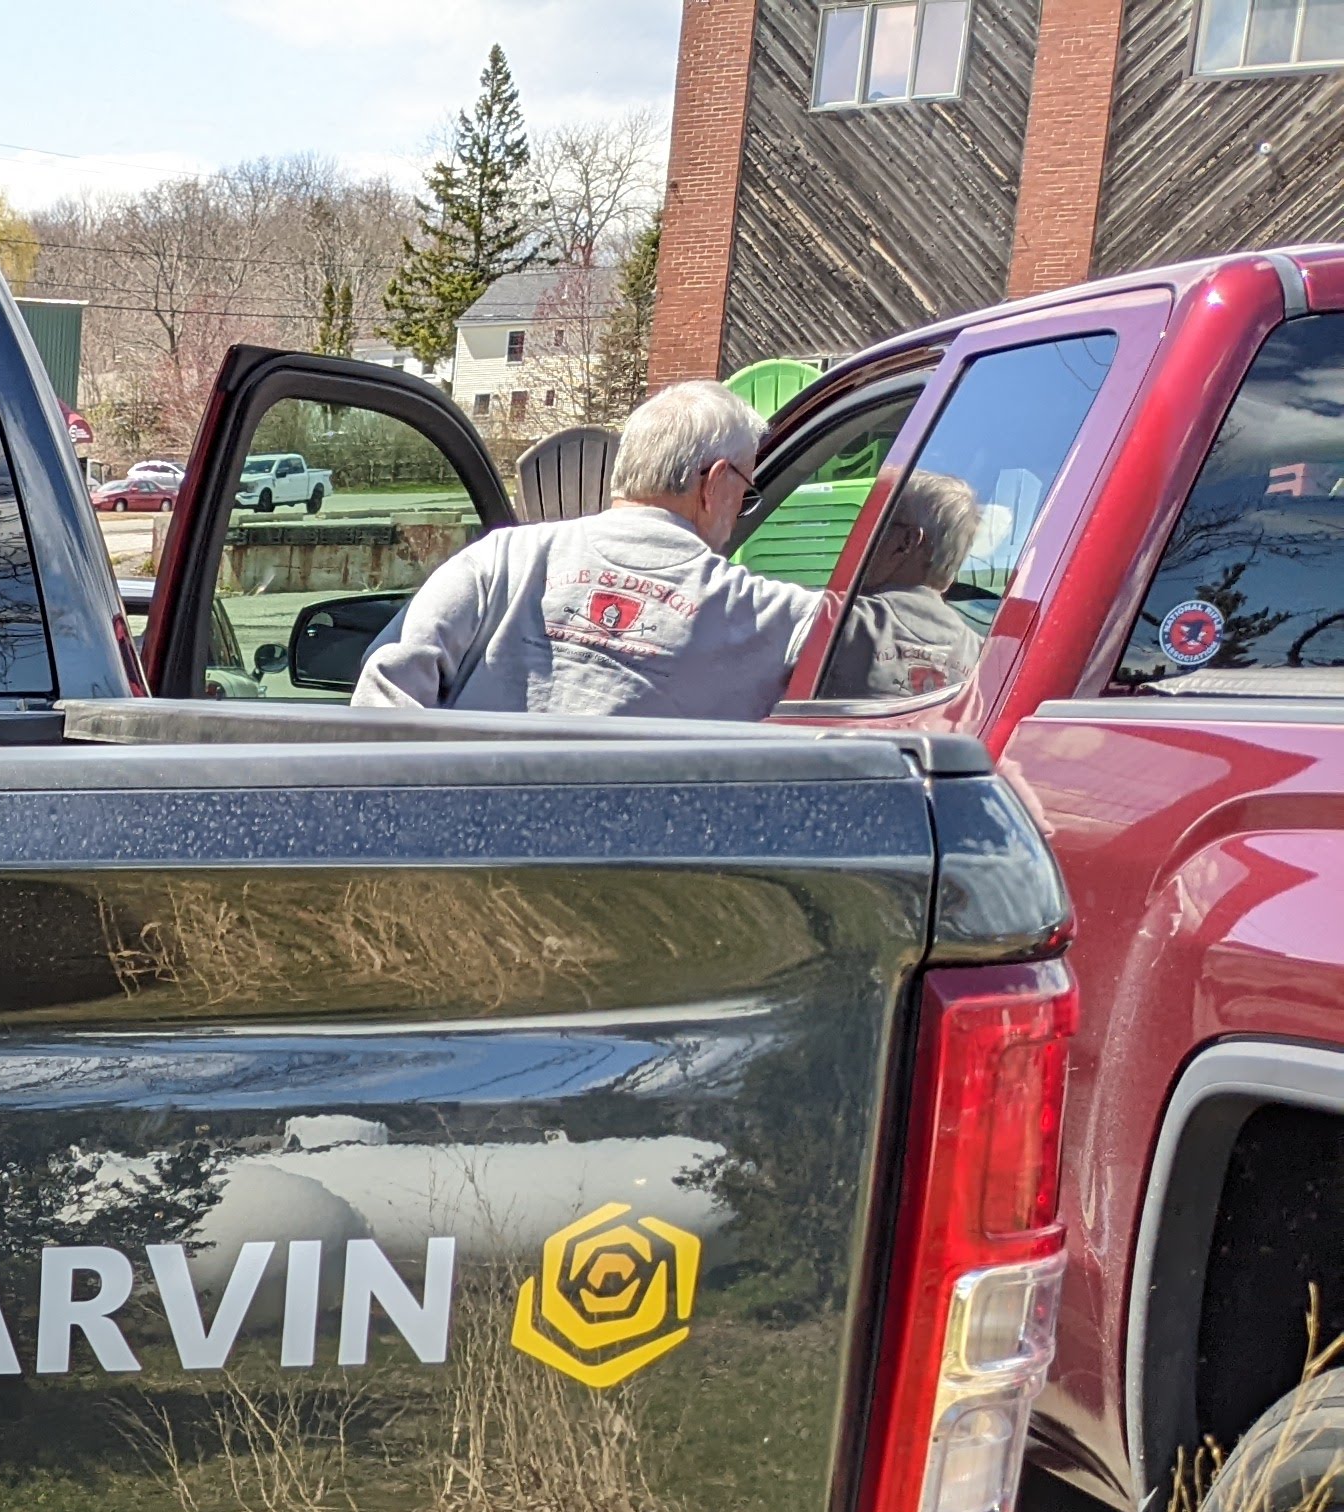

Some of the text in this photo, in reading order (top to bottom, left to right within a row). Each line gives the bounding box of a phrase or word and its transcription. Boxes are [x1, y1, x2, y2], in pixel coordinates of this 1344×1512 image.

[598, 570, 617, 587] &
[622, 574, 700, 620] DESIGN
[1163, 603, 1223, 630] NATIONAL RIFLE
[1165, 641, 1219, 661] ASSOCIATION
